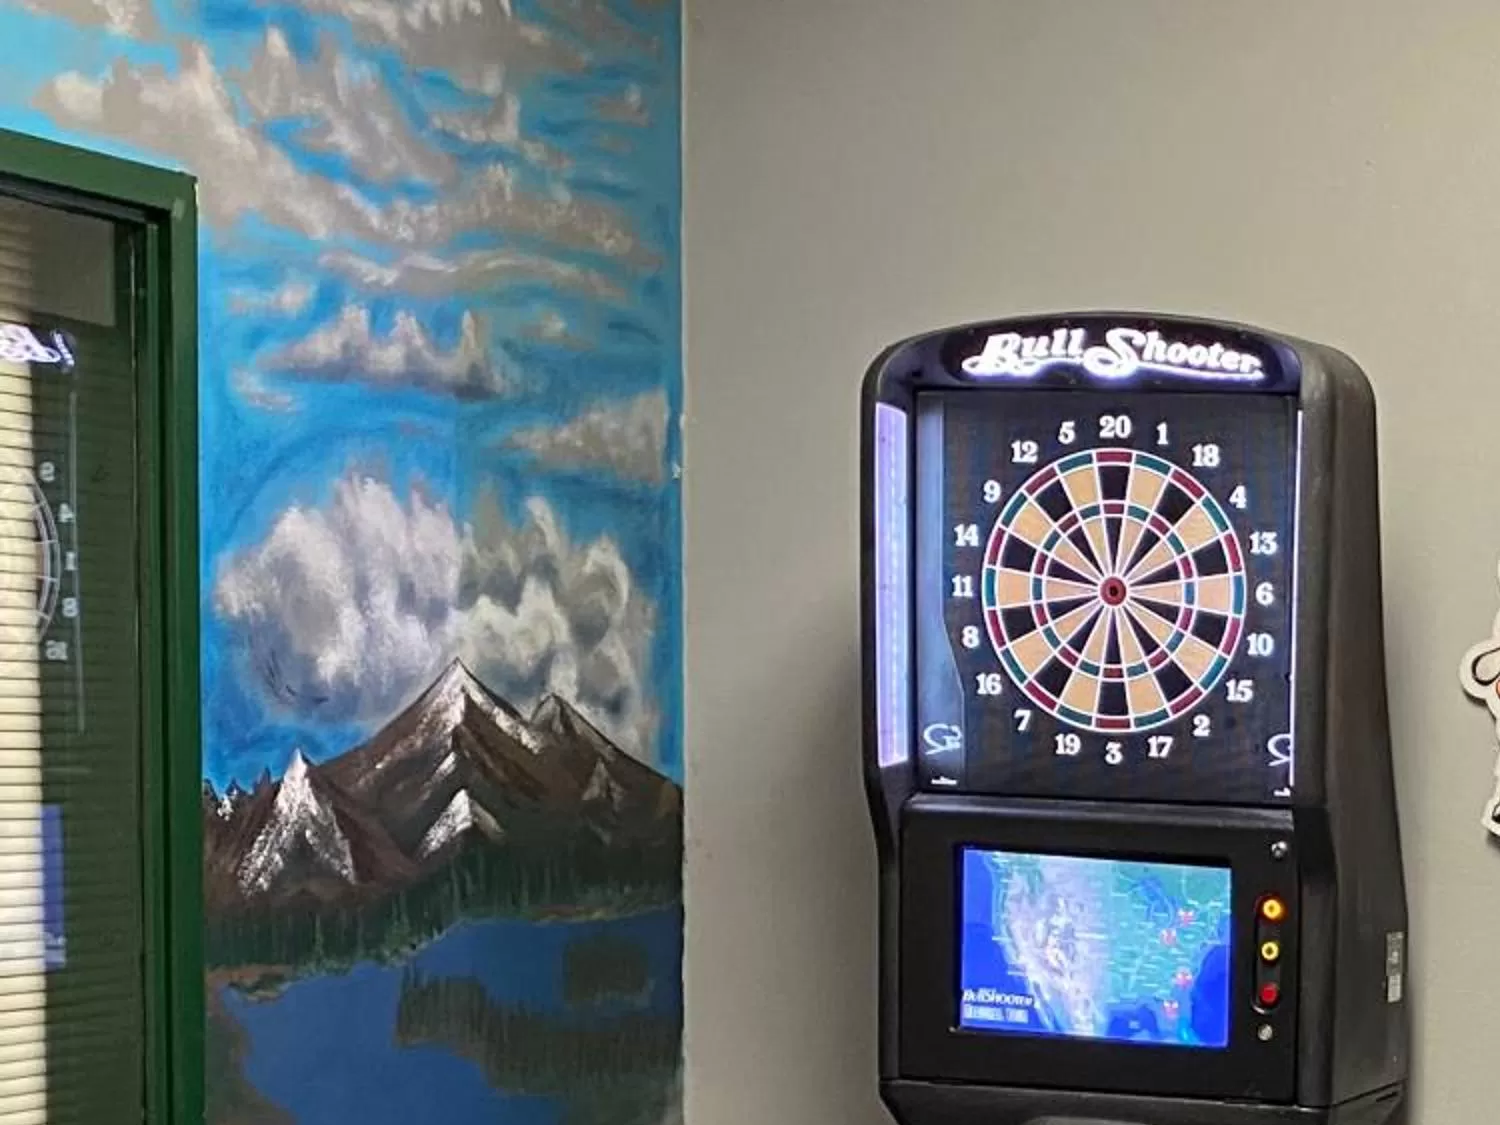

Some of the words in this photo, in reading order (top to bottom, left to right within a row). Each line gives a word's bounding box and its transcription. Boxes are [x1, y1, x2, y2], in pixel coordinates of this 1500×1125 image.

[962, 328, 1086, 377] Bull
[1083, 327, 1264, 380] Shooter
[1058, 420, 1076, 445] 5
[1099, 415, 1132, 439] 20
[1156, 422, 1169, 446] 1
[1011, 439, 1038, 464] 12
[1192, 443, 1221, 468] 18
[983, 479, 1002, 504] 9
[1229, 485, 1248, 509] 4
[953, 523, 980, 547] 14
[1249, 531, 1279, 556] 13
[952, 576, 974, 598] 11
[1255, 581, 1275, 607] 6
[962, 625, 980, 649] 8
[1246, 632, 1275, 657] 10
[975, 672, 1003, 696] 16
[1225, 679, 1254, 703] 15
[1014, 708, 1032, 731] 7
[1193, 714, 1211, 737] 2
[1055, 733, 1082, 756] 19
[1105, 741, 1123, 765] 3
[1147, 735, 1174, 758] 17
